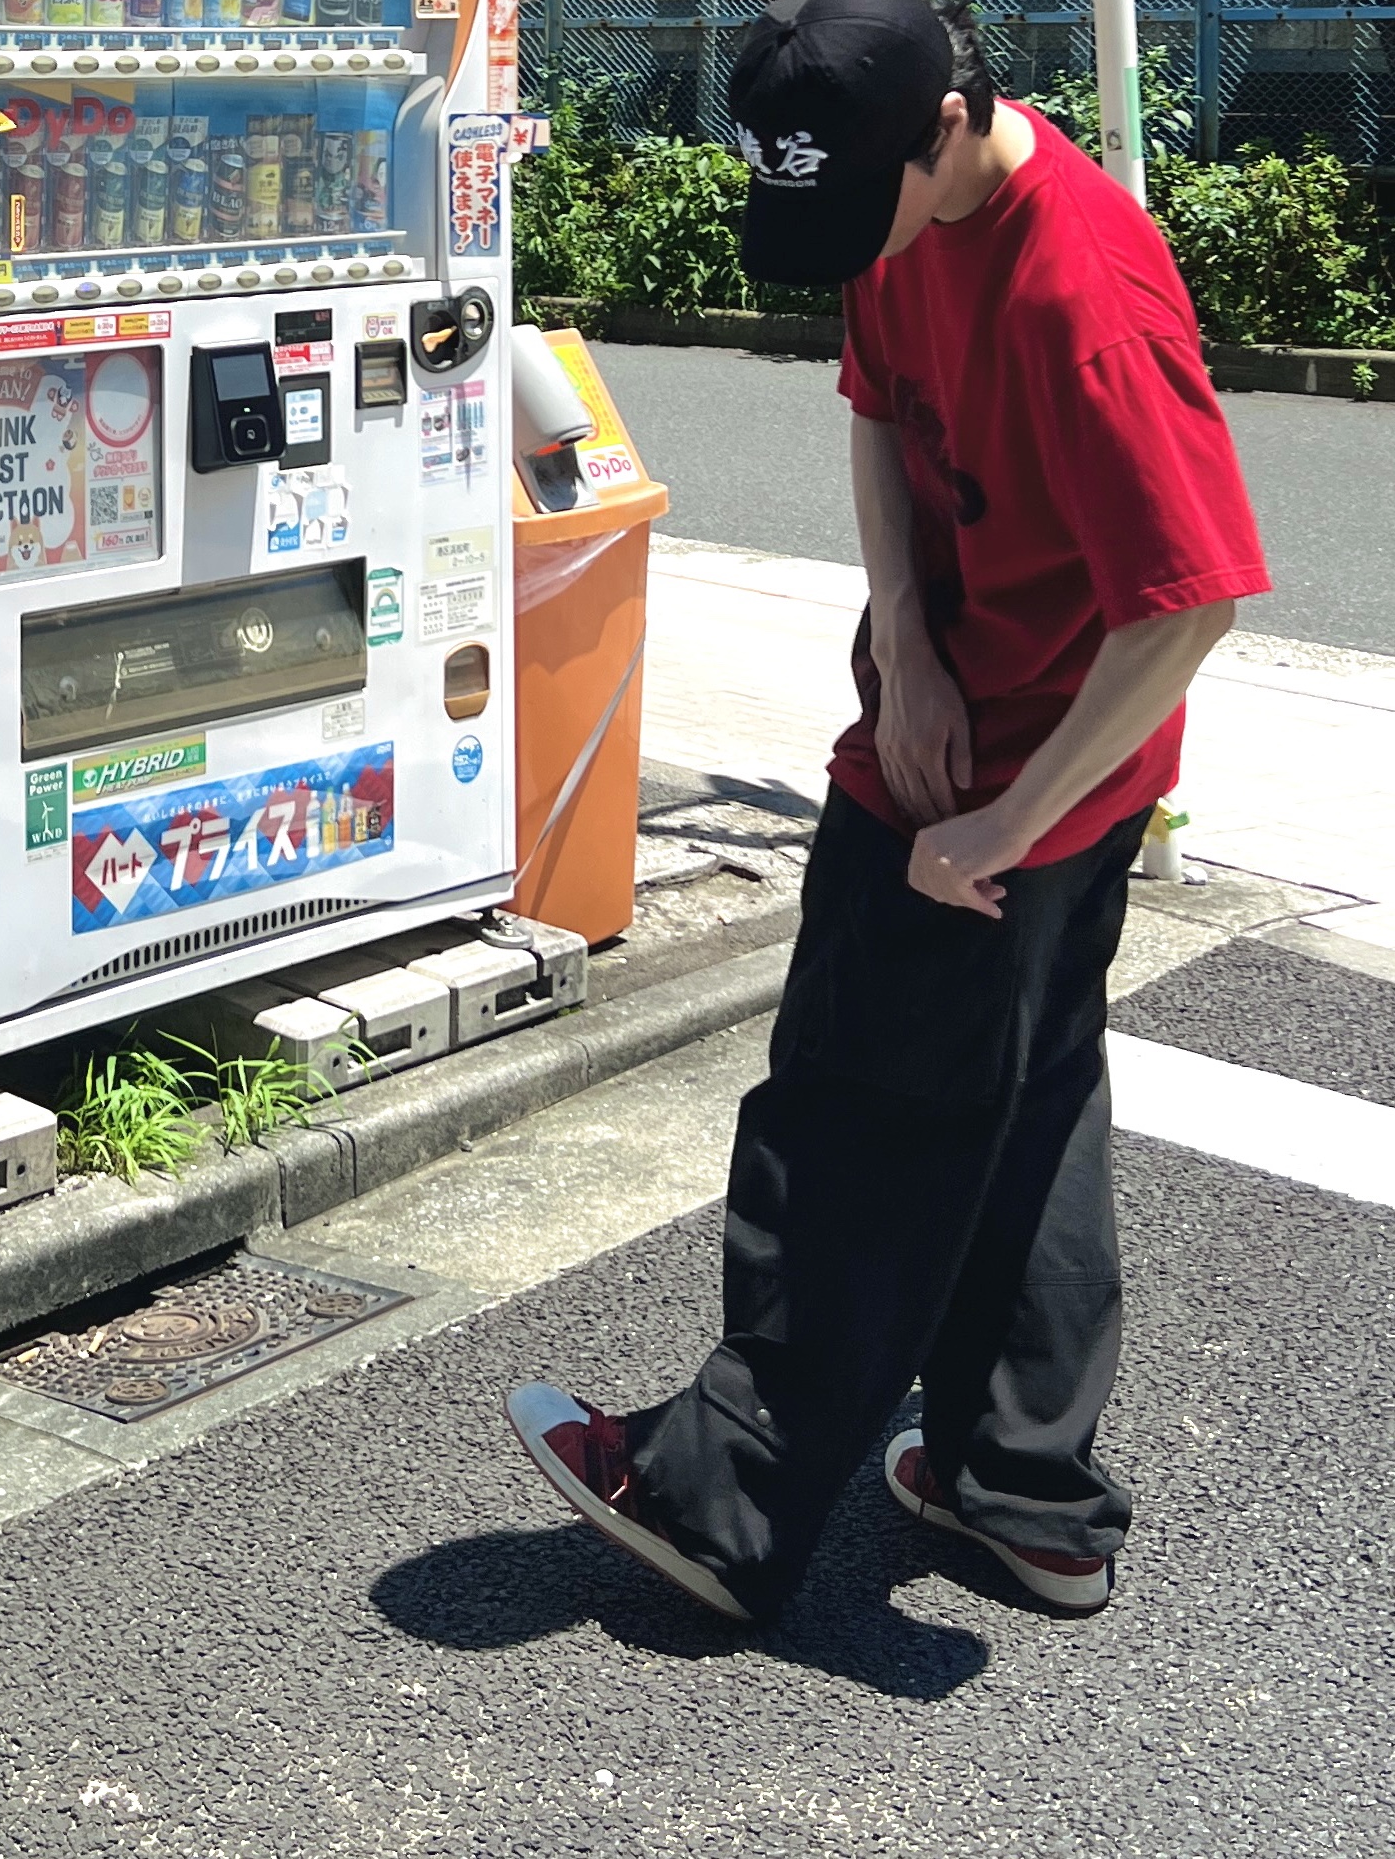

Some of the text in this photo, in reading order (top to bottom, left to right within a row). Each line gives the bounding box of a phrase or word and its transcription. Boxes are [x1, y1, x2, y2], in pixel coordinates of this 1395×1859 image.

[8, 96, 136, 150] DyDo
[454, 123, 503, 141] CASHLESS
[453, 150, 473, 251] 使えます!
[475, 142, 495, 245] 電子マネー
[20, 365, 33, 380] to
[587, 457, 632, 480] DyDo
[30, 769, 63, 785] Green
[95, 748, 185, 795] HYBRID
[29, 781, 64, 796] Power
[32, 828, 63, 844] WIND
[162, 800, 298, 892] プライス
[103, 852, 143, 886] ハート
